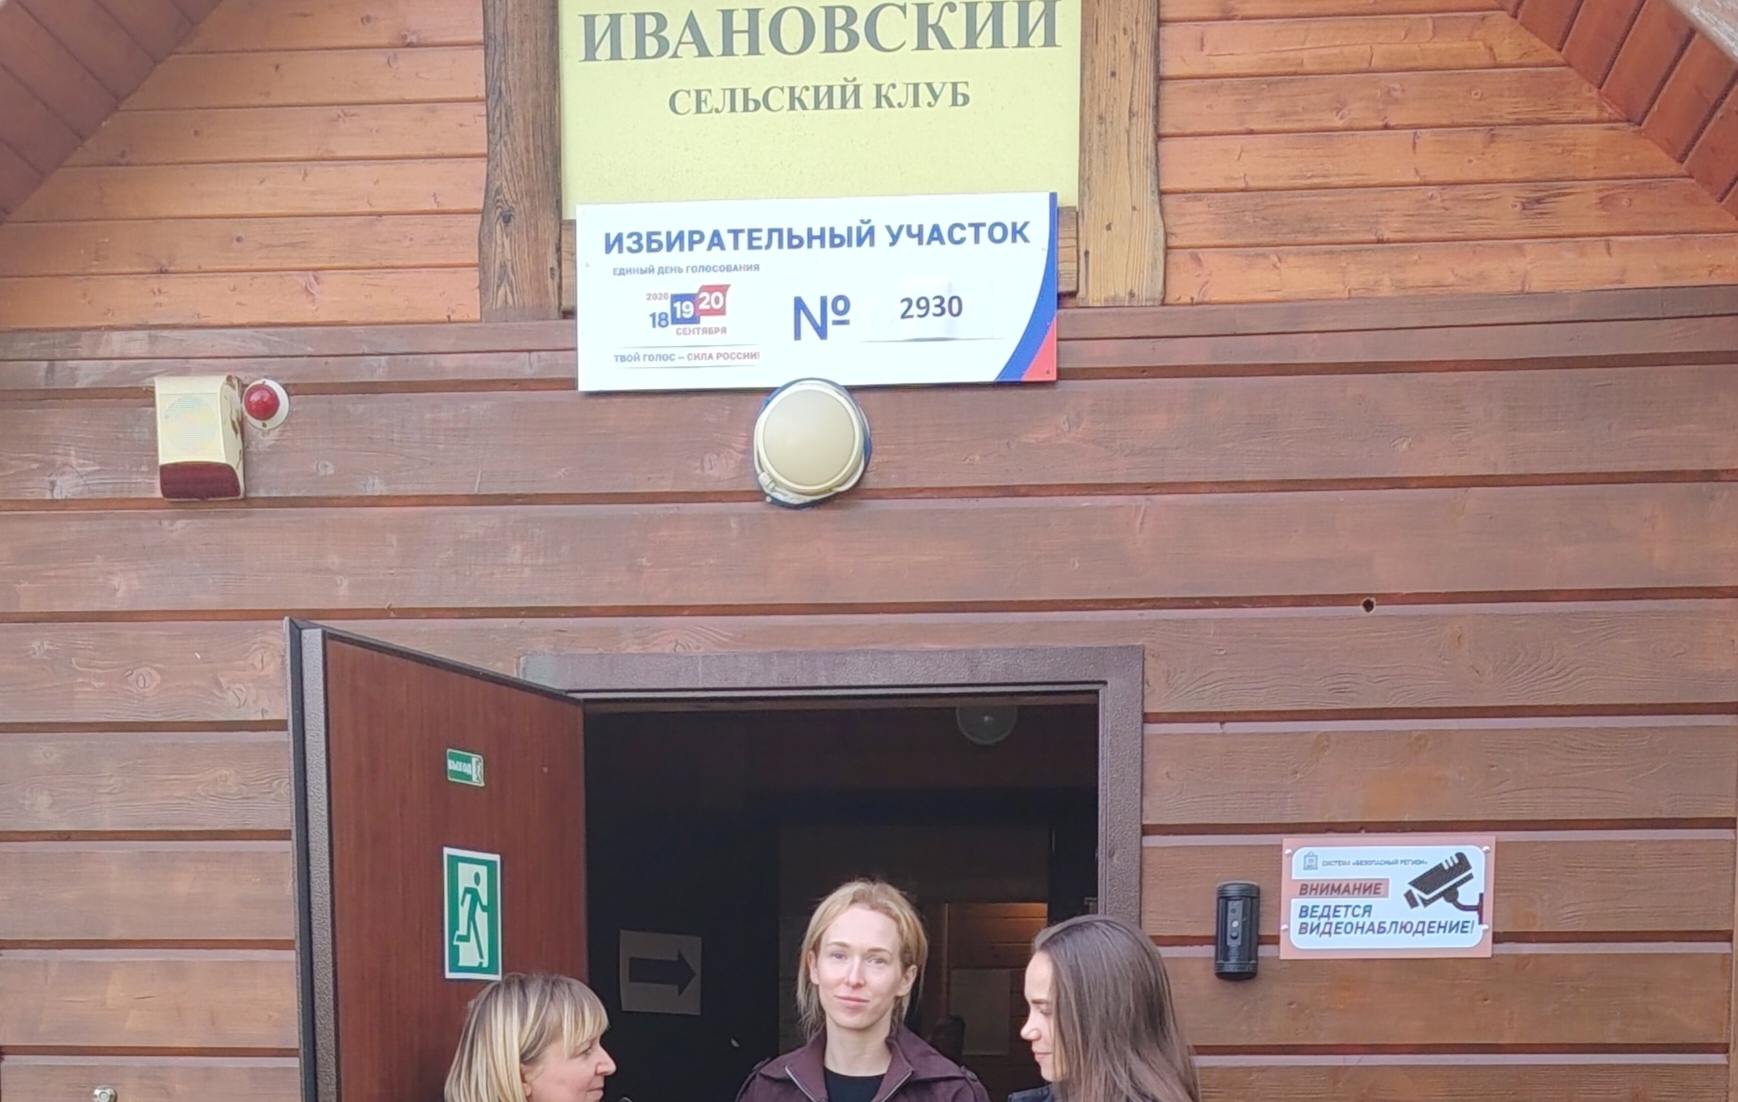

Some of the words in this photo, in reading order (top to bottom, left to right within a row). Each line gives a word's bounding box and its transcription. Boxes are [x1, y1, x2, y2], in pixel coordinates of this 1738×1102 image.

[668, 77, 864, 116] СЕЛЬСКИЙ
[872, 81, 971, 110] КЛУБ
[604, 219, 876, 255] ИЗБИРАТЕЛЬНЫЙ
[884, 221, 1031, 247] УЧАСТОК
[612, 265, 655, 276] ЕДИНЫЙ
[657, 265, 684, 275] ДЕНЬ
[686, 264, 760, 274] ГОЛОСОВАНИЯ
[646, 292, 669, 301] 2026
[649, 312, 669, 328] 18
[673, 300, 695, 319] 19
[698, 291, 724, 310] 20
[899, 294, 963, 319] 2930
[676, 326, 727, 336] СЕНТЯБРЯ
[614, 352, 640, 363] ТВОЙ
[643, 353, 676, 362] ГОЛОС
[687, 352, 714, 361] СИЛА
[1299, 882, 1383, 896] ВНИМАНИЕ
[1299, 904, 1373, 920] ВЕДЕТСЯ
[1298, 919, 1475, 938] ВИДЕОНАБЛЮДЕНИЕ!
